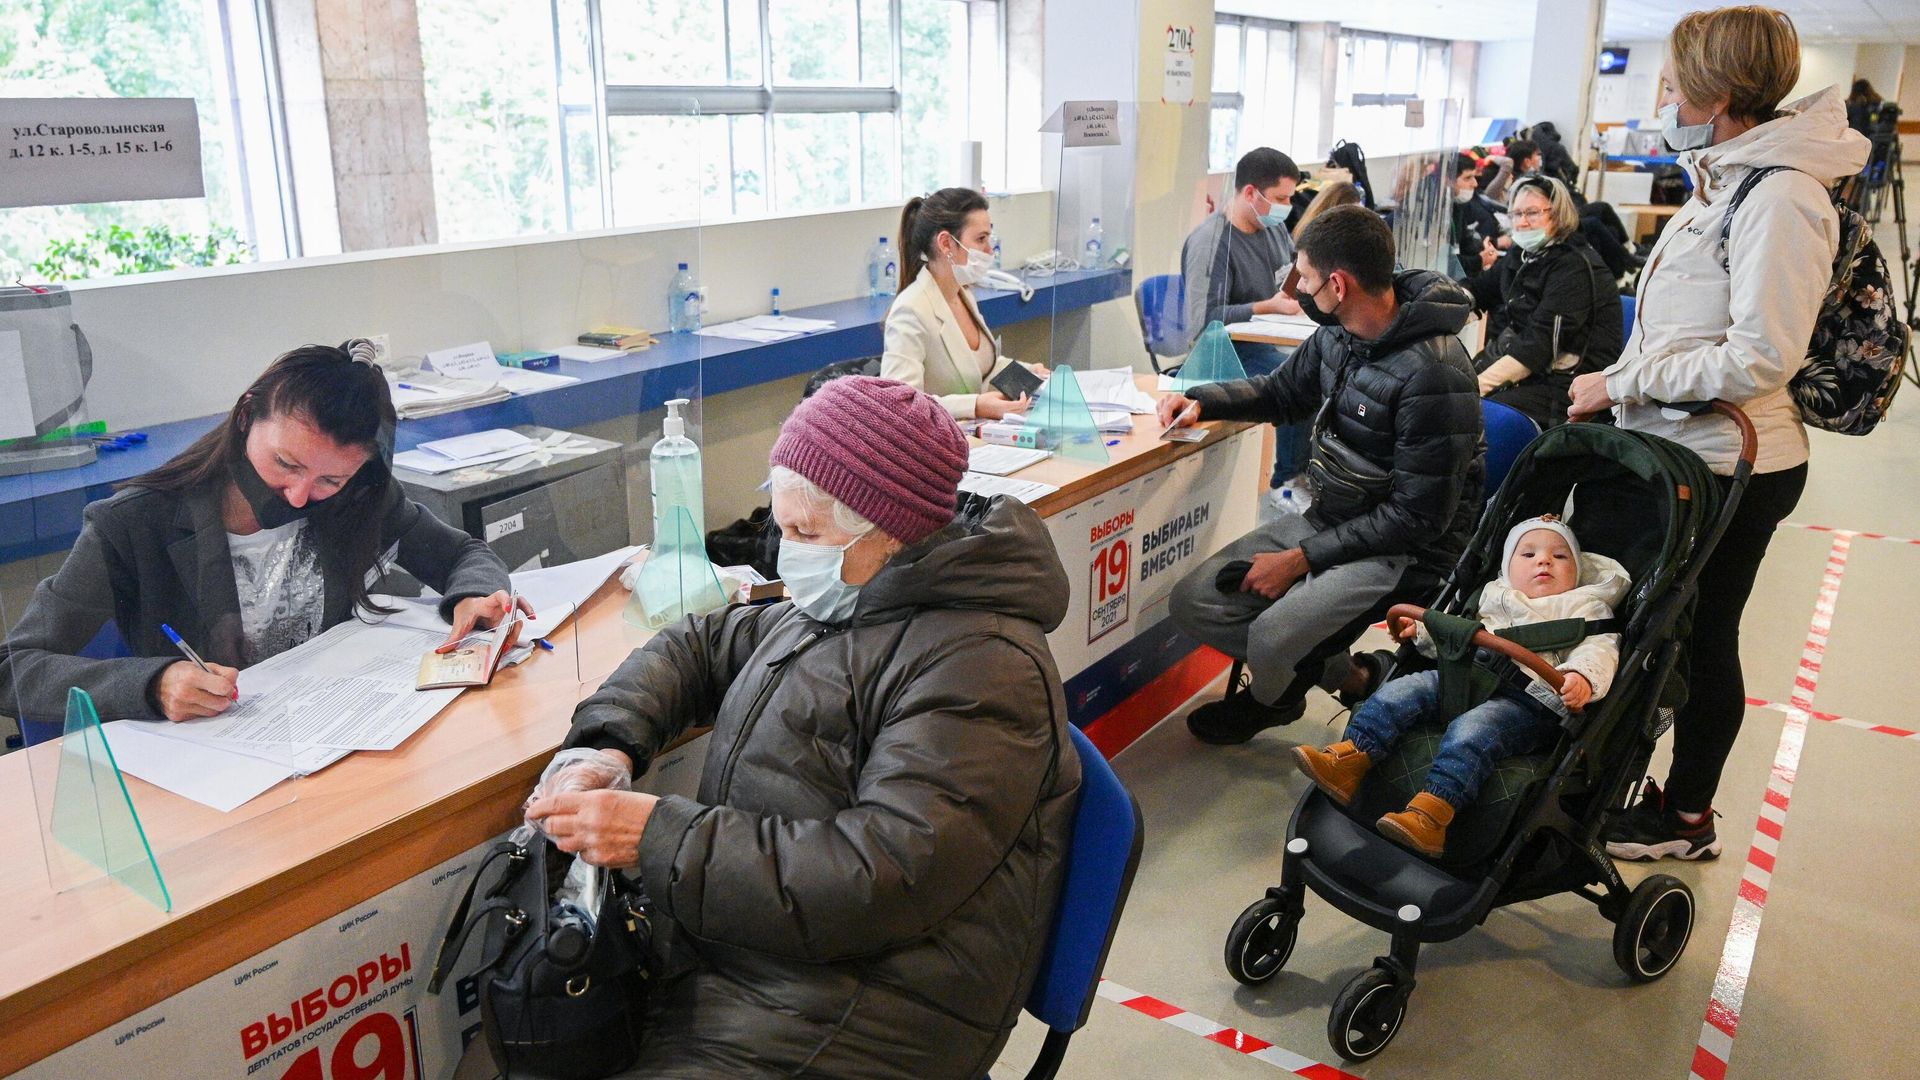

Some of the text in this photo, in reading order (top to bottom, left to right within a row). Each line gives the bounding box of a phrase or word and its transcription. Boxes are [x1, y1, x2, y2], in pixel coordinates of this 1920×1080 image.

[1168, 28, 1192, 49] 2704
[13, 123, 165, 140] ул.Староволынская
[9, 140, 173, 158] д. 12 к. 1-5, д. 15 к. 1-6
[499, 520, 517, 533] 2704
[1090, 508, 1135, 543] ВЫБОРЫ
[1142, 502, 1210, 555] ВЫБИРАЕМ
[1093, 539, 1128, 602] 19
[1140, 535, 1194, 582] ВМЕСТЕ!
[1092, 593, 1127, 621] СЕНТЯБРЯ
[1101, 611, 1117, 628] 2021
[339, 909, 378, 933] ЦИК России
[234, 960, 279, 986] ЦИК России
[240, 942, 412, 1061] ВЫБОРЫ
[114, 1016, 165, 1046] ЦИК России
[247, 975, 414, 1076] ДЕПУТАТОВ ГОСУДАРСТВЕННОЙ ДУМЫ
[280, 1012, 406, 1080] 9
